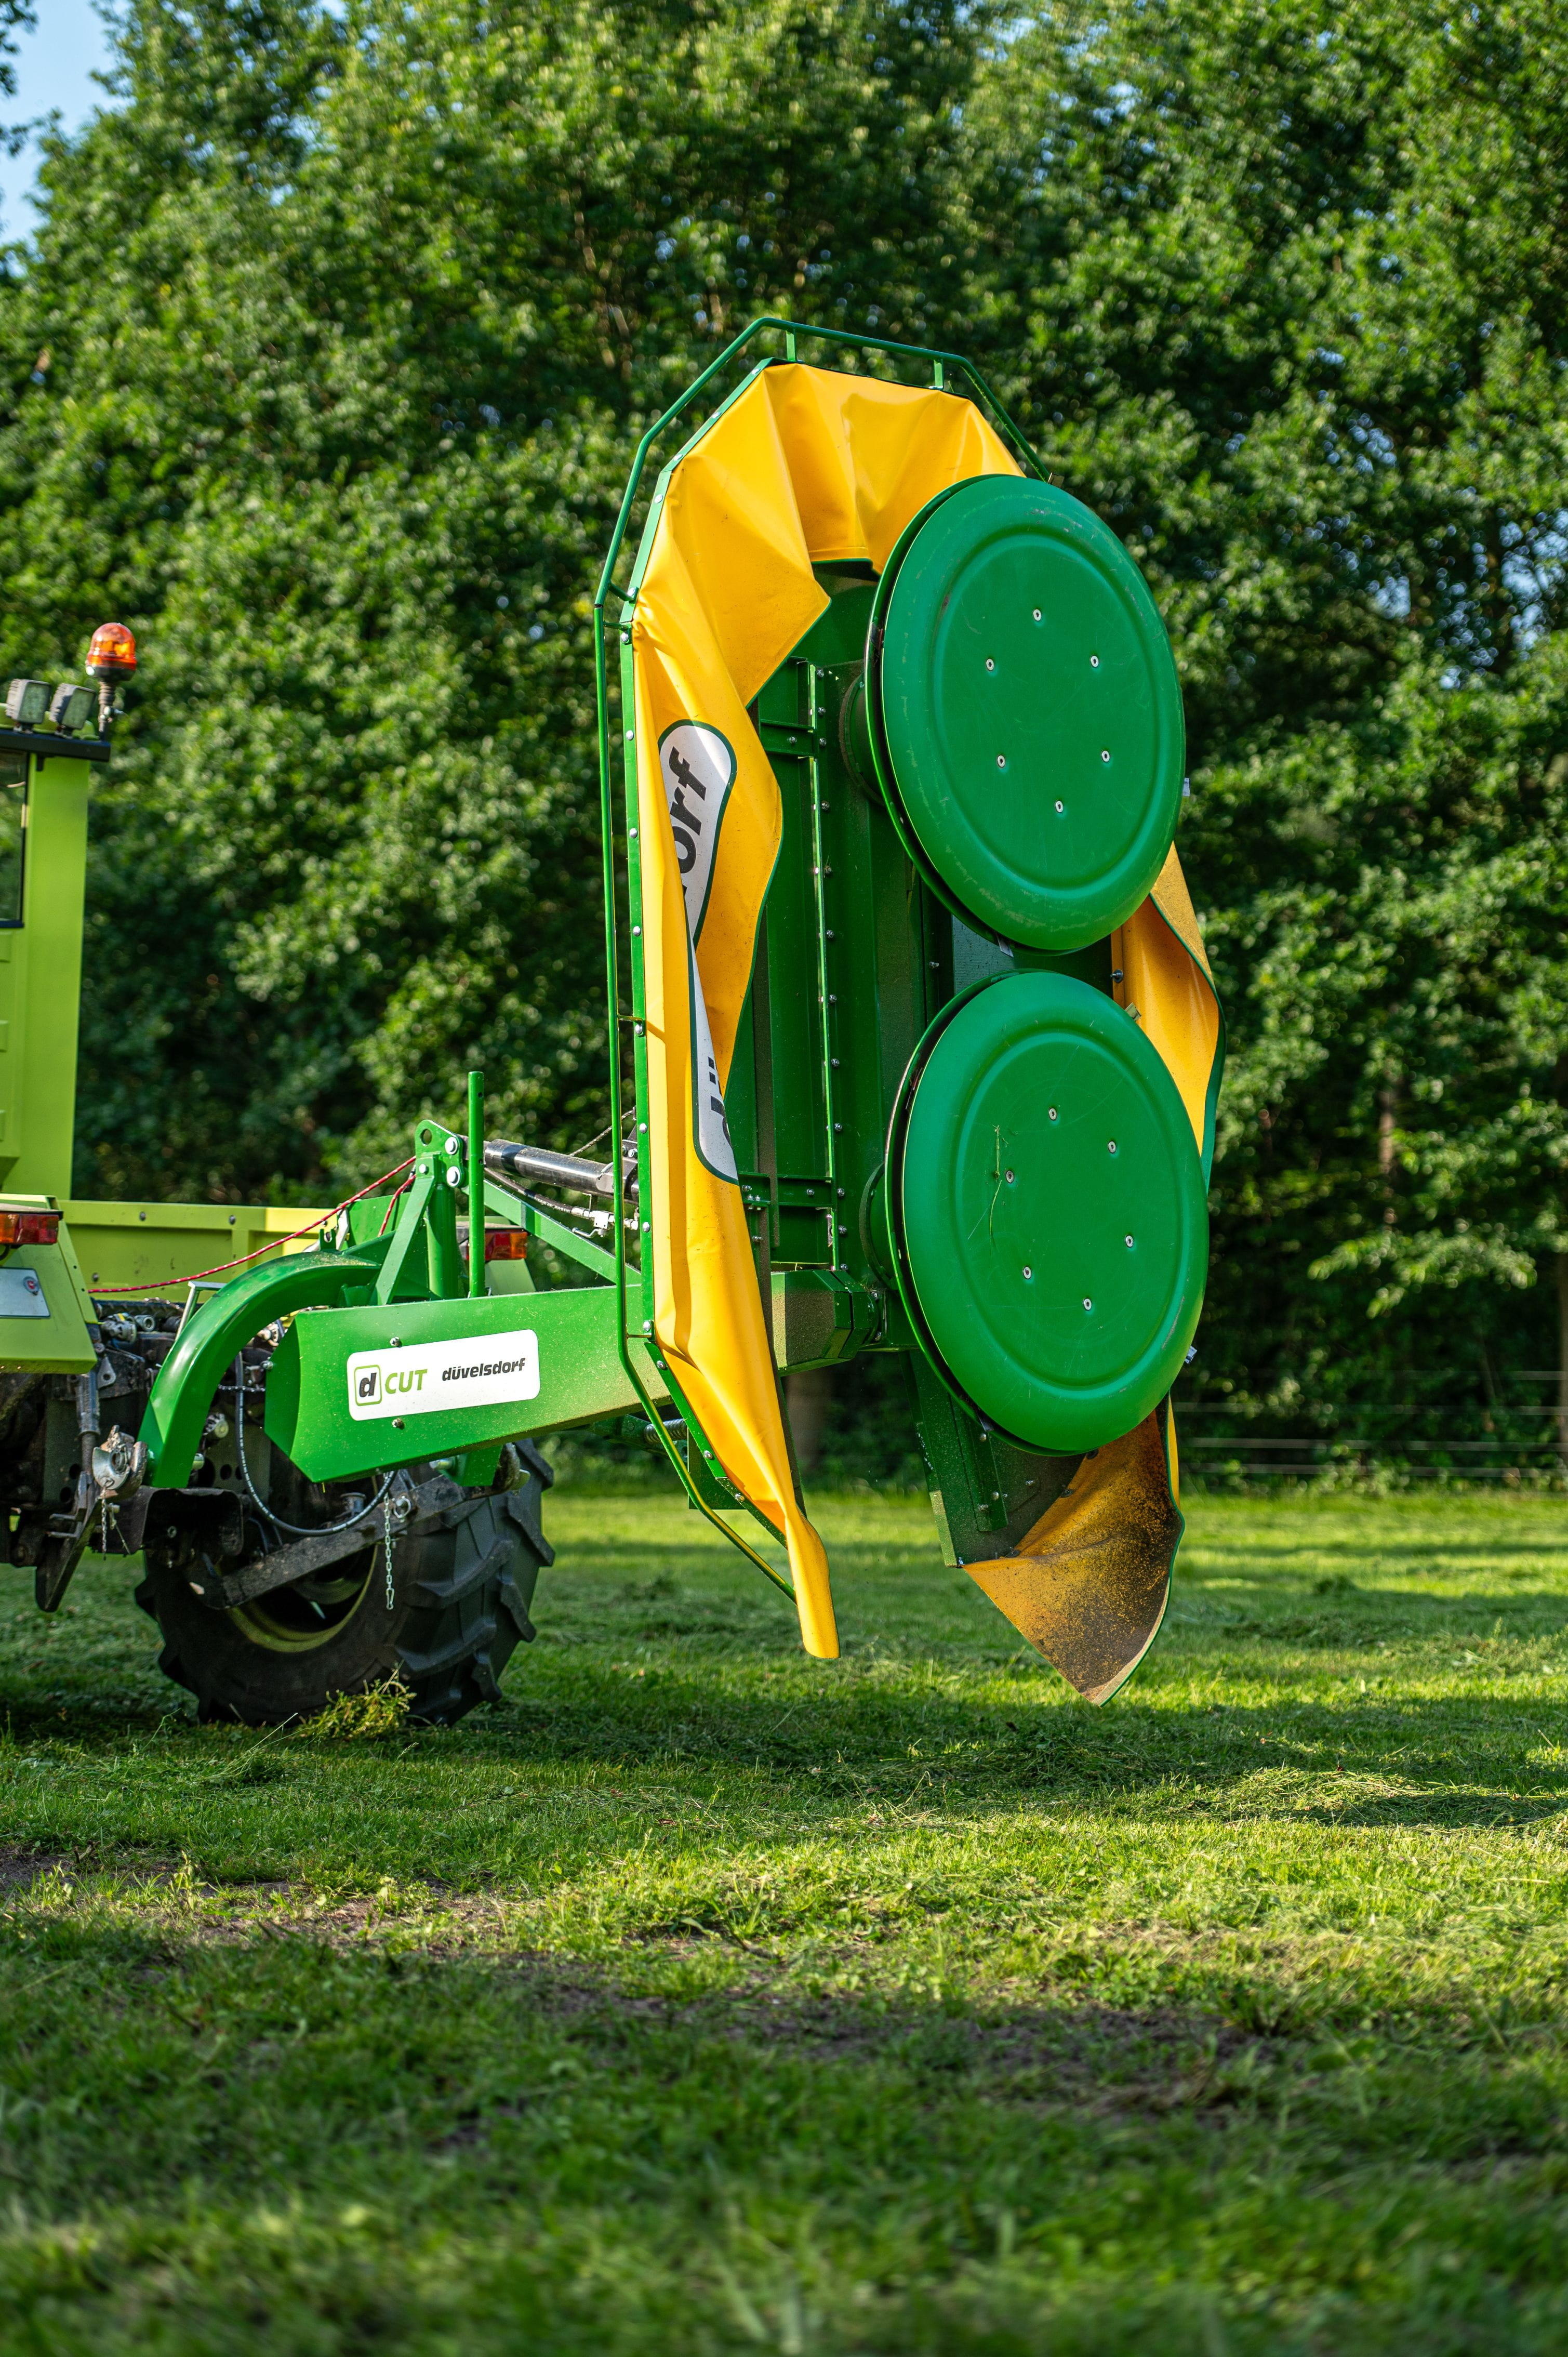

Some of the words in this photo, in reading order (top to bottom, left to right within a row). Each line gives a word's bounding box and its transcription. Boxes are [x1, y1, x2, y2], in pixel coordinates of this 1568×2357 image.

[669, 746, 707, 897] orf
[359, 1372, 377, 1398] d
[385, 1369, 428, 1394] CUT
[442, 1357, 526, 1381] düvelsdorf
